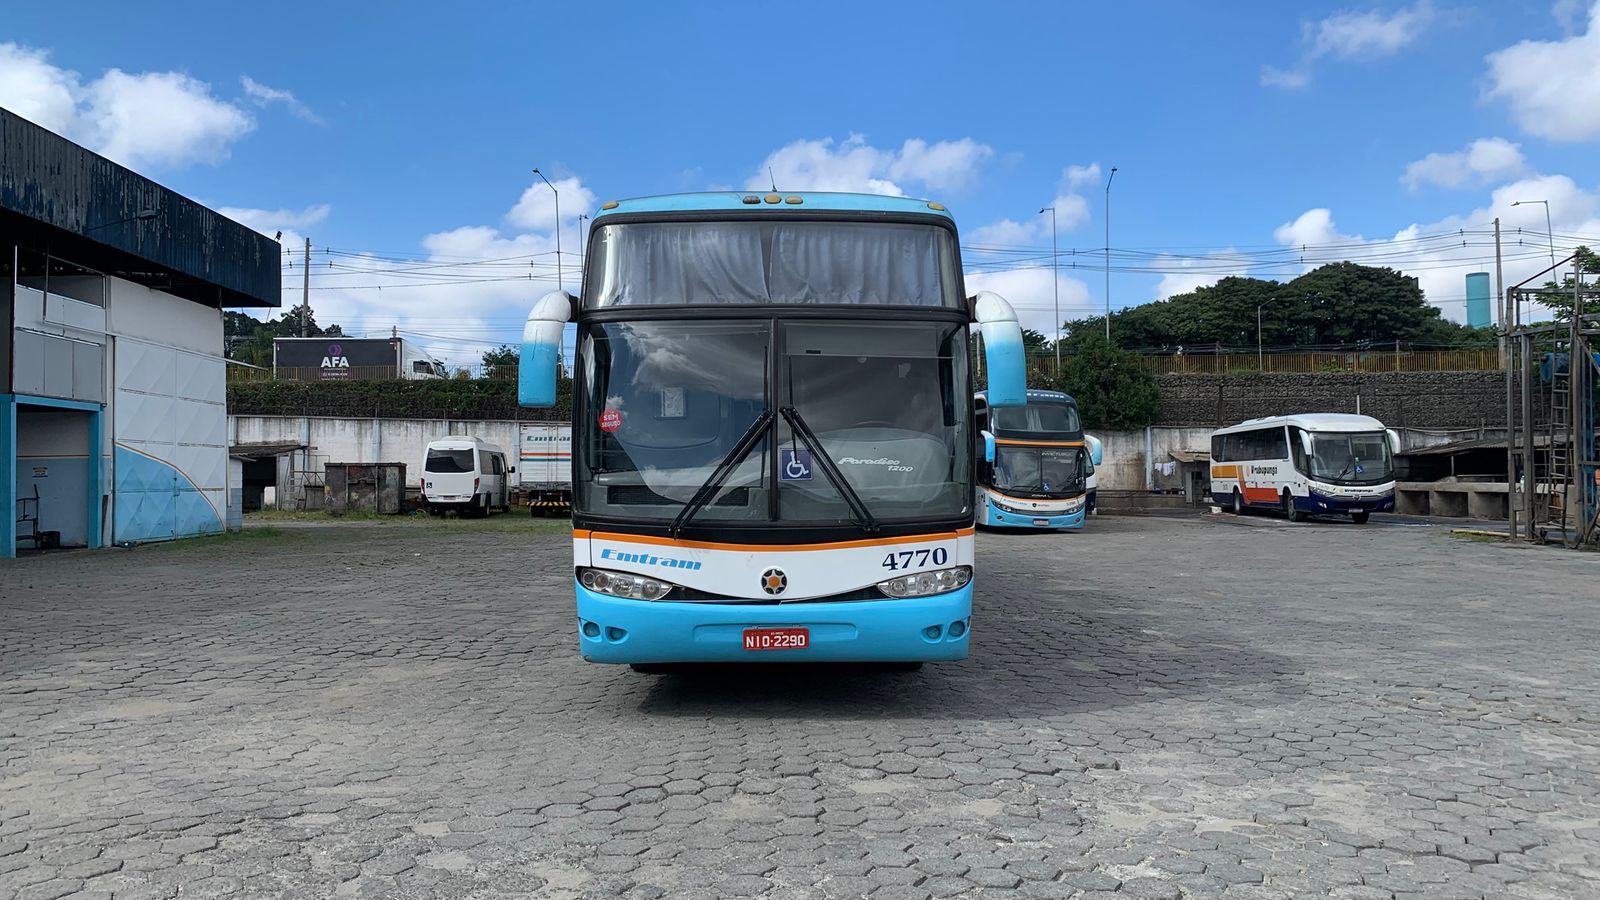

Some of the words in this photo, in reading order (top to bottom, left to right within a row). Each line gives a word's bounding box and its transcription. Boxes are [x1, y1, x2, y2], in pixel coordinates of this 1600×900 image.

[320, 356, 350, 368] AFA
[601, 548, 702, 571] Emtram
[881, 547, 948, 571] 4770
